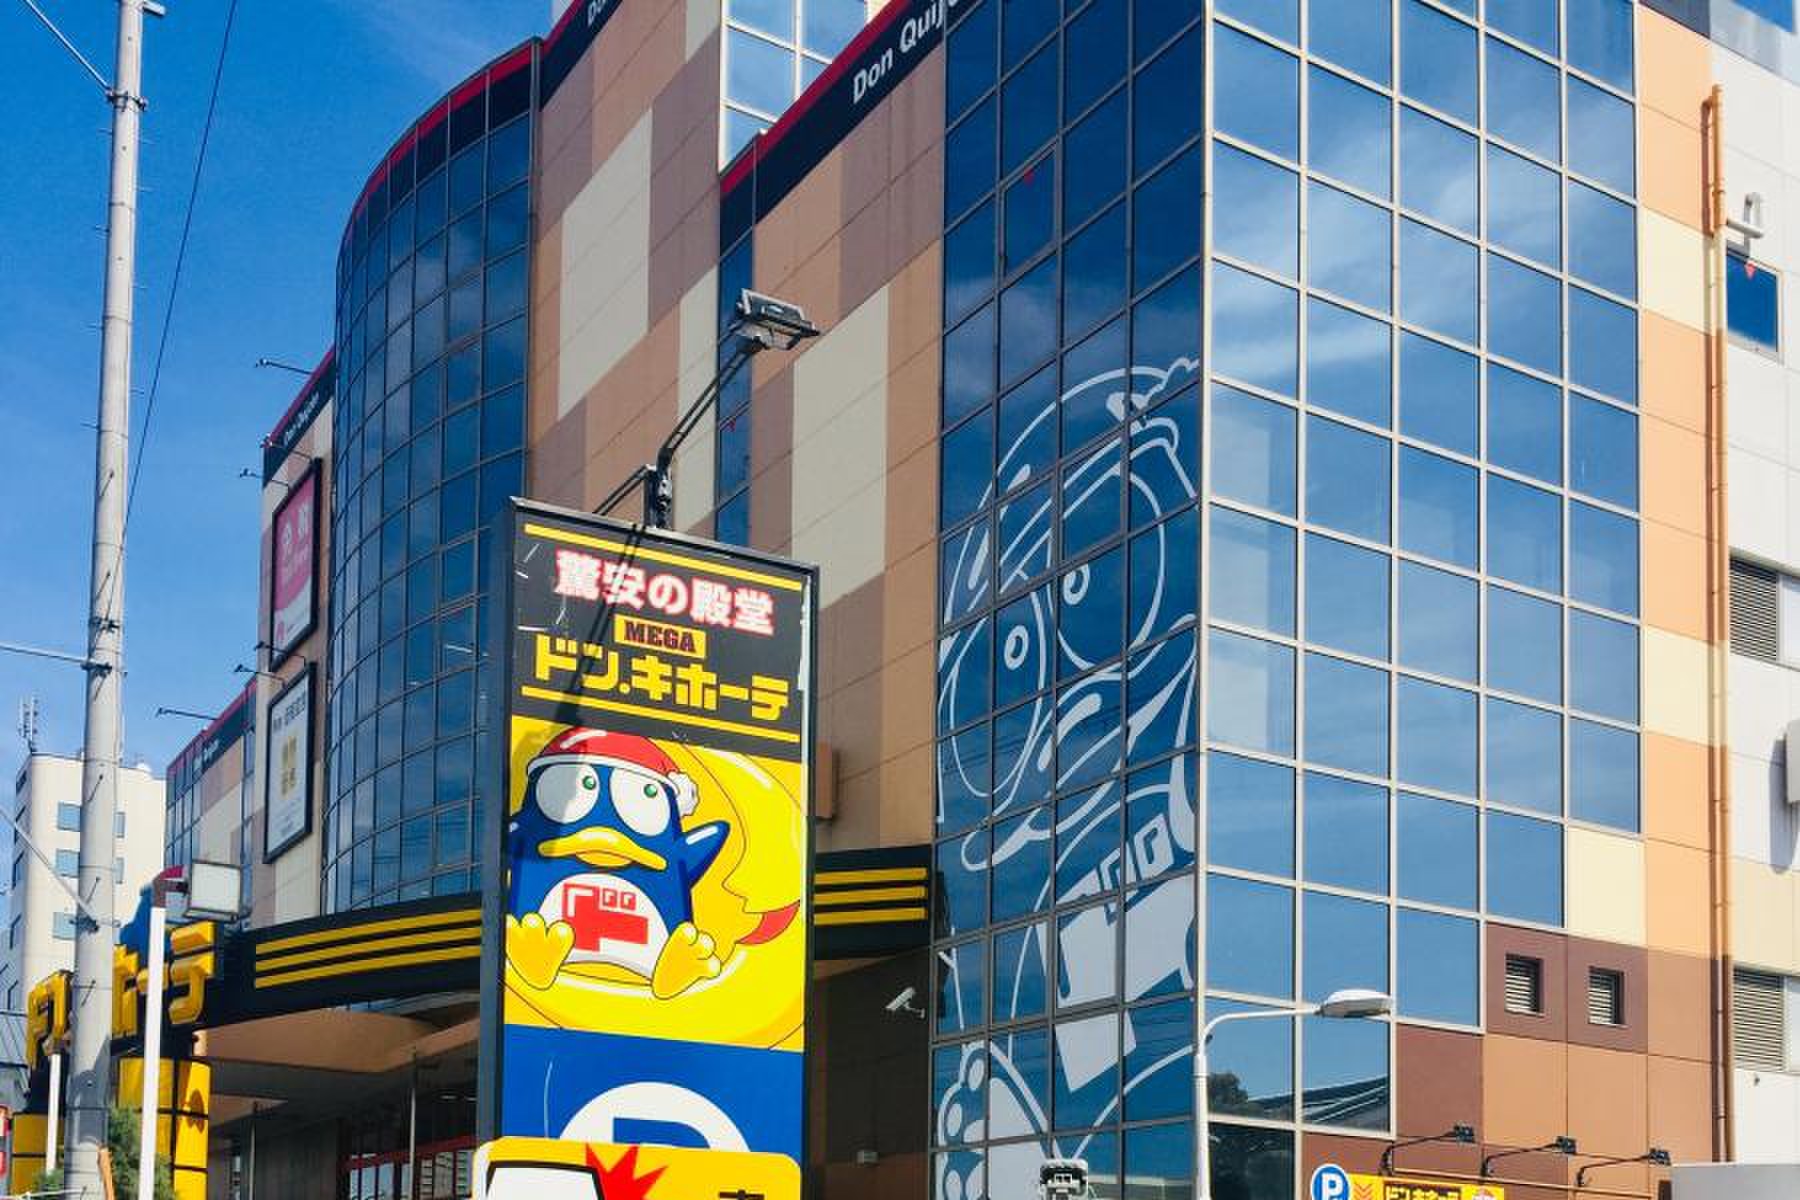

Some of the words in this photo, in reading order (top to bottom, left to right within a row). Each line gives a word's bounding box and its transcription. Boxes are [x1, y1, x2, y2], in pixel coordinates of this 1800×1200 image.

[853, 47, 893, 104] Don
[900, 0, 958, 53] Quij
[554, 548, 775, 637] 驚安の殿堂
[623, 620, 697, 654] MEGA
